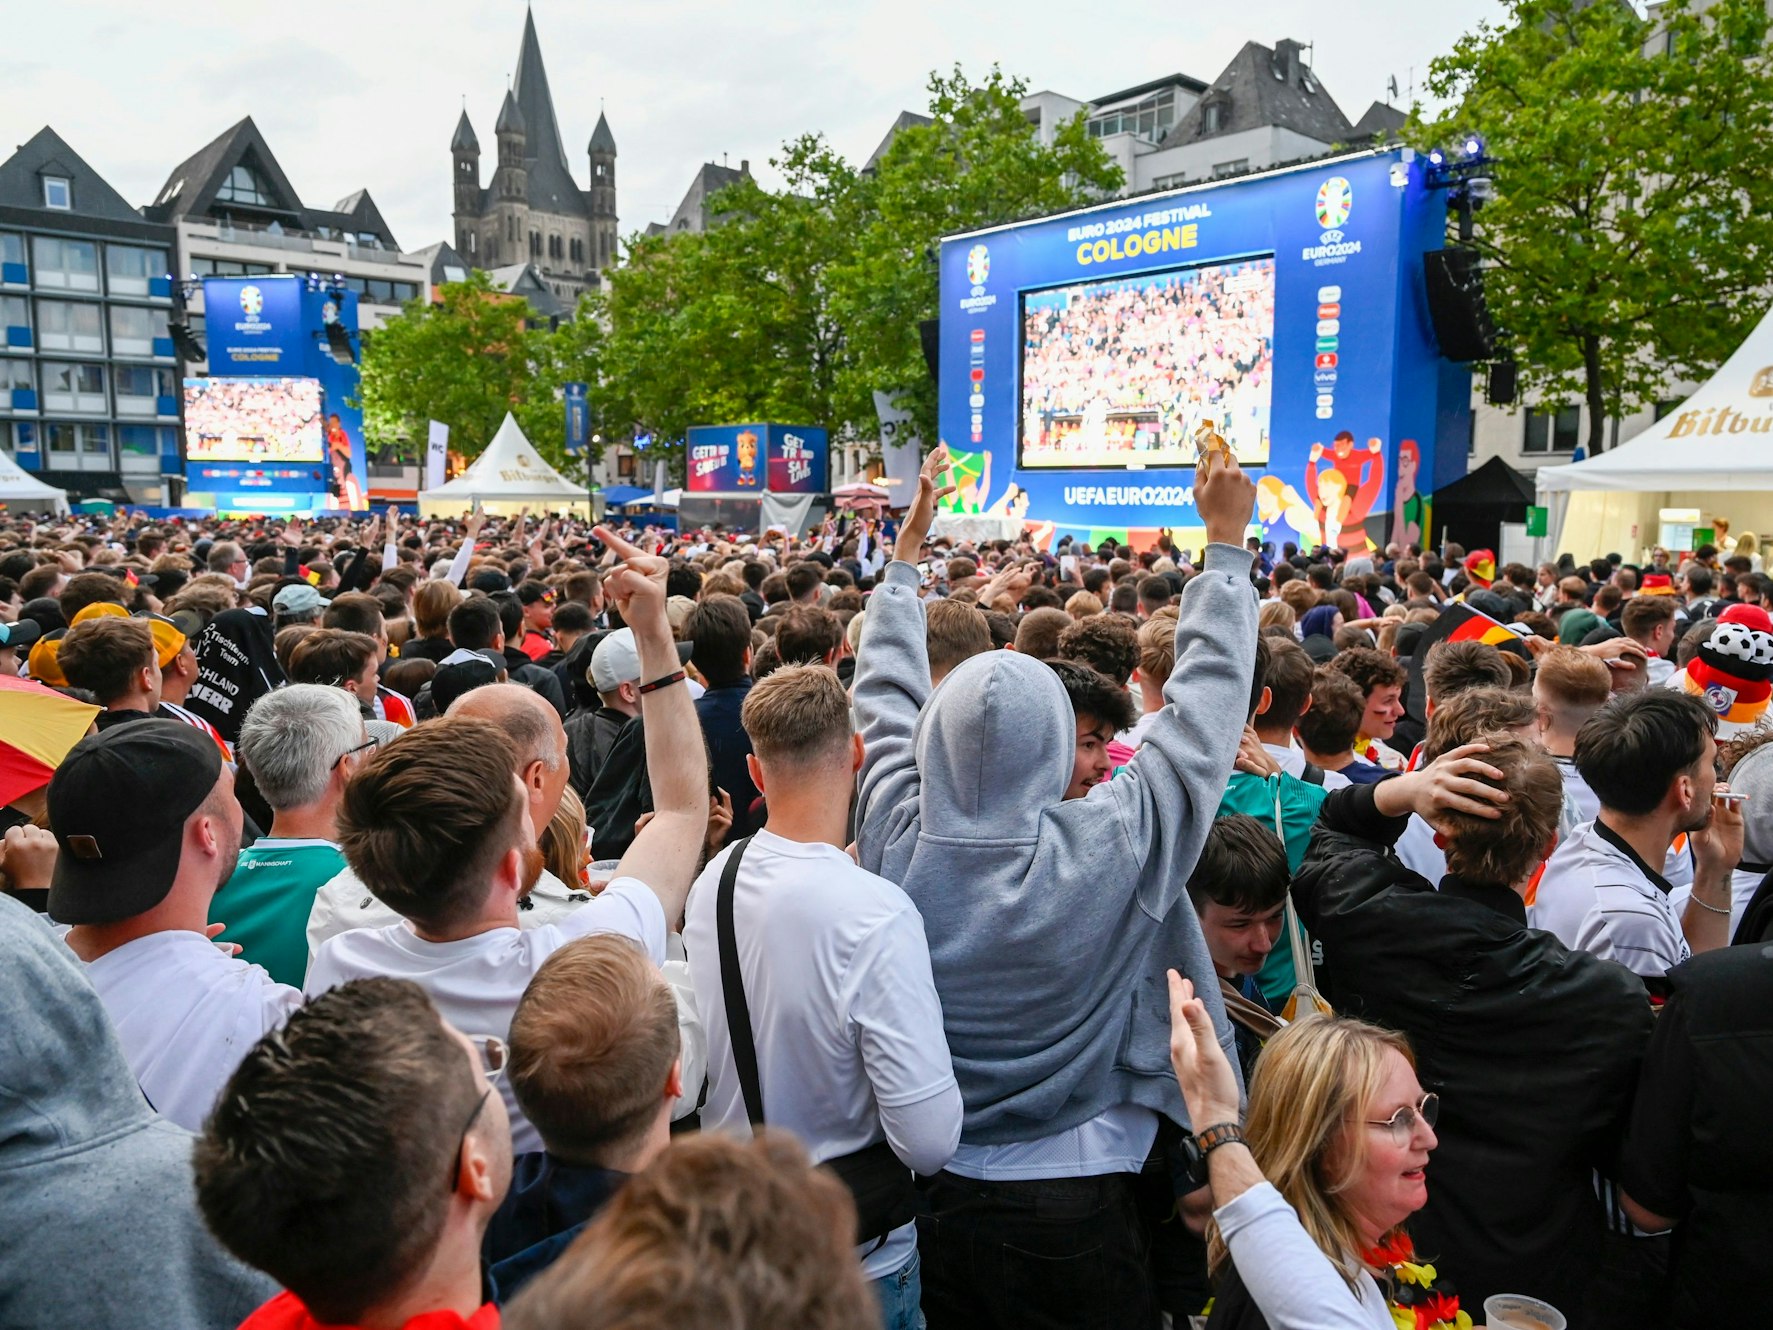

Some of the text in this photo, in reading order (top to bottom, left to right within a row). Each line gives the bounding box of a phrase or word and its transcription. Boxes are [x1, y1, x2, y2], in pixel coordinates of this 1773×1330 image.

[1067, 203, 1212, 242] EURO 2024 FESTIVAL
[1076, 223, 1198, 266] COLOGNE
[1302, 240, 1362, 261] EURO2024
[1664, 405, 1773, 440] Bitbu
[211, 631, 250, 666] Tischtenn
[220, 647, 240, 667] Team
[197, 666, 240, 697] CHLAND
